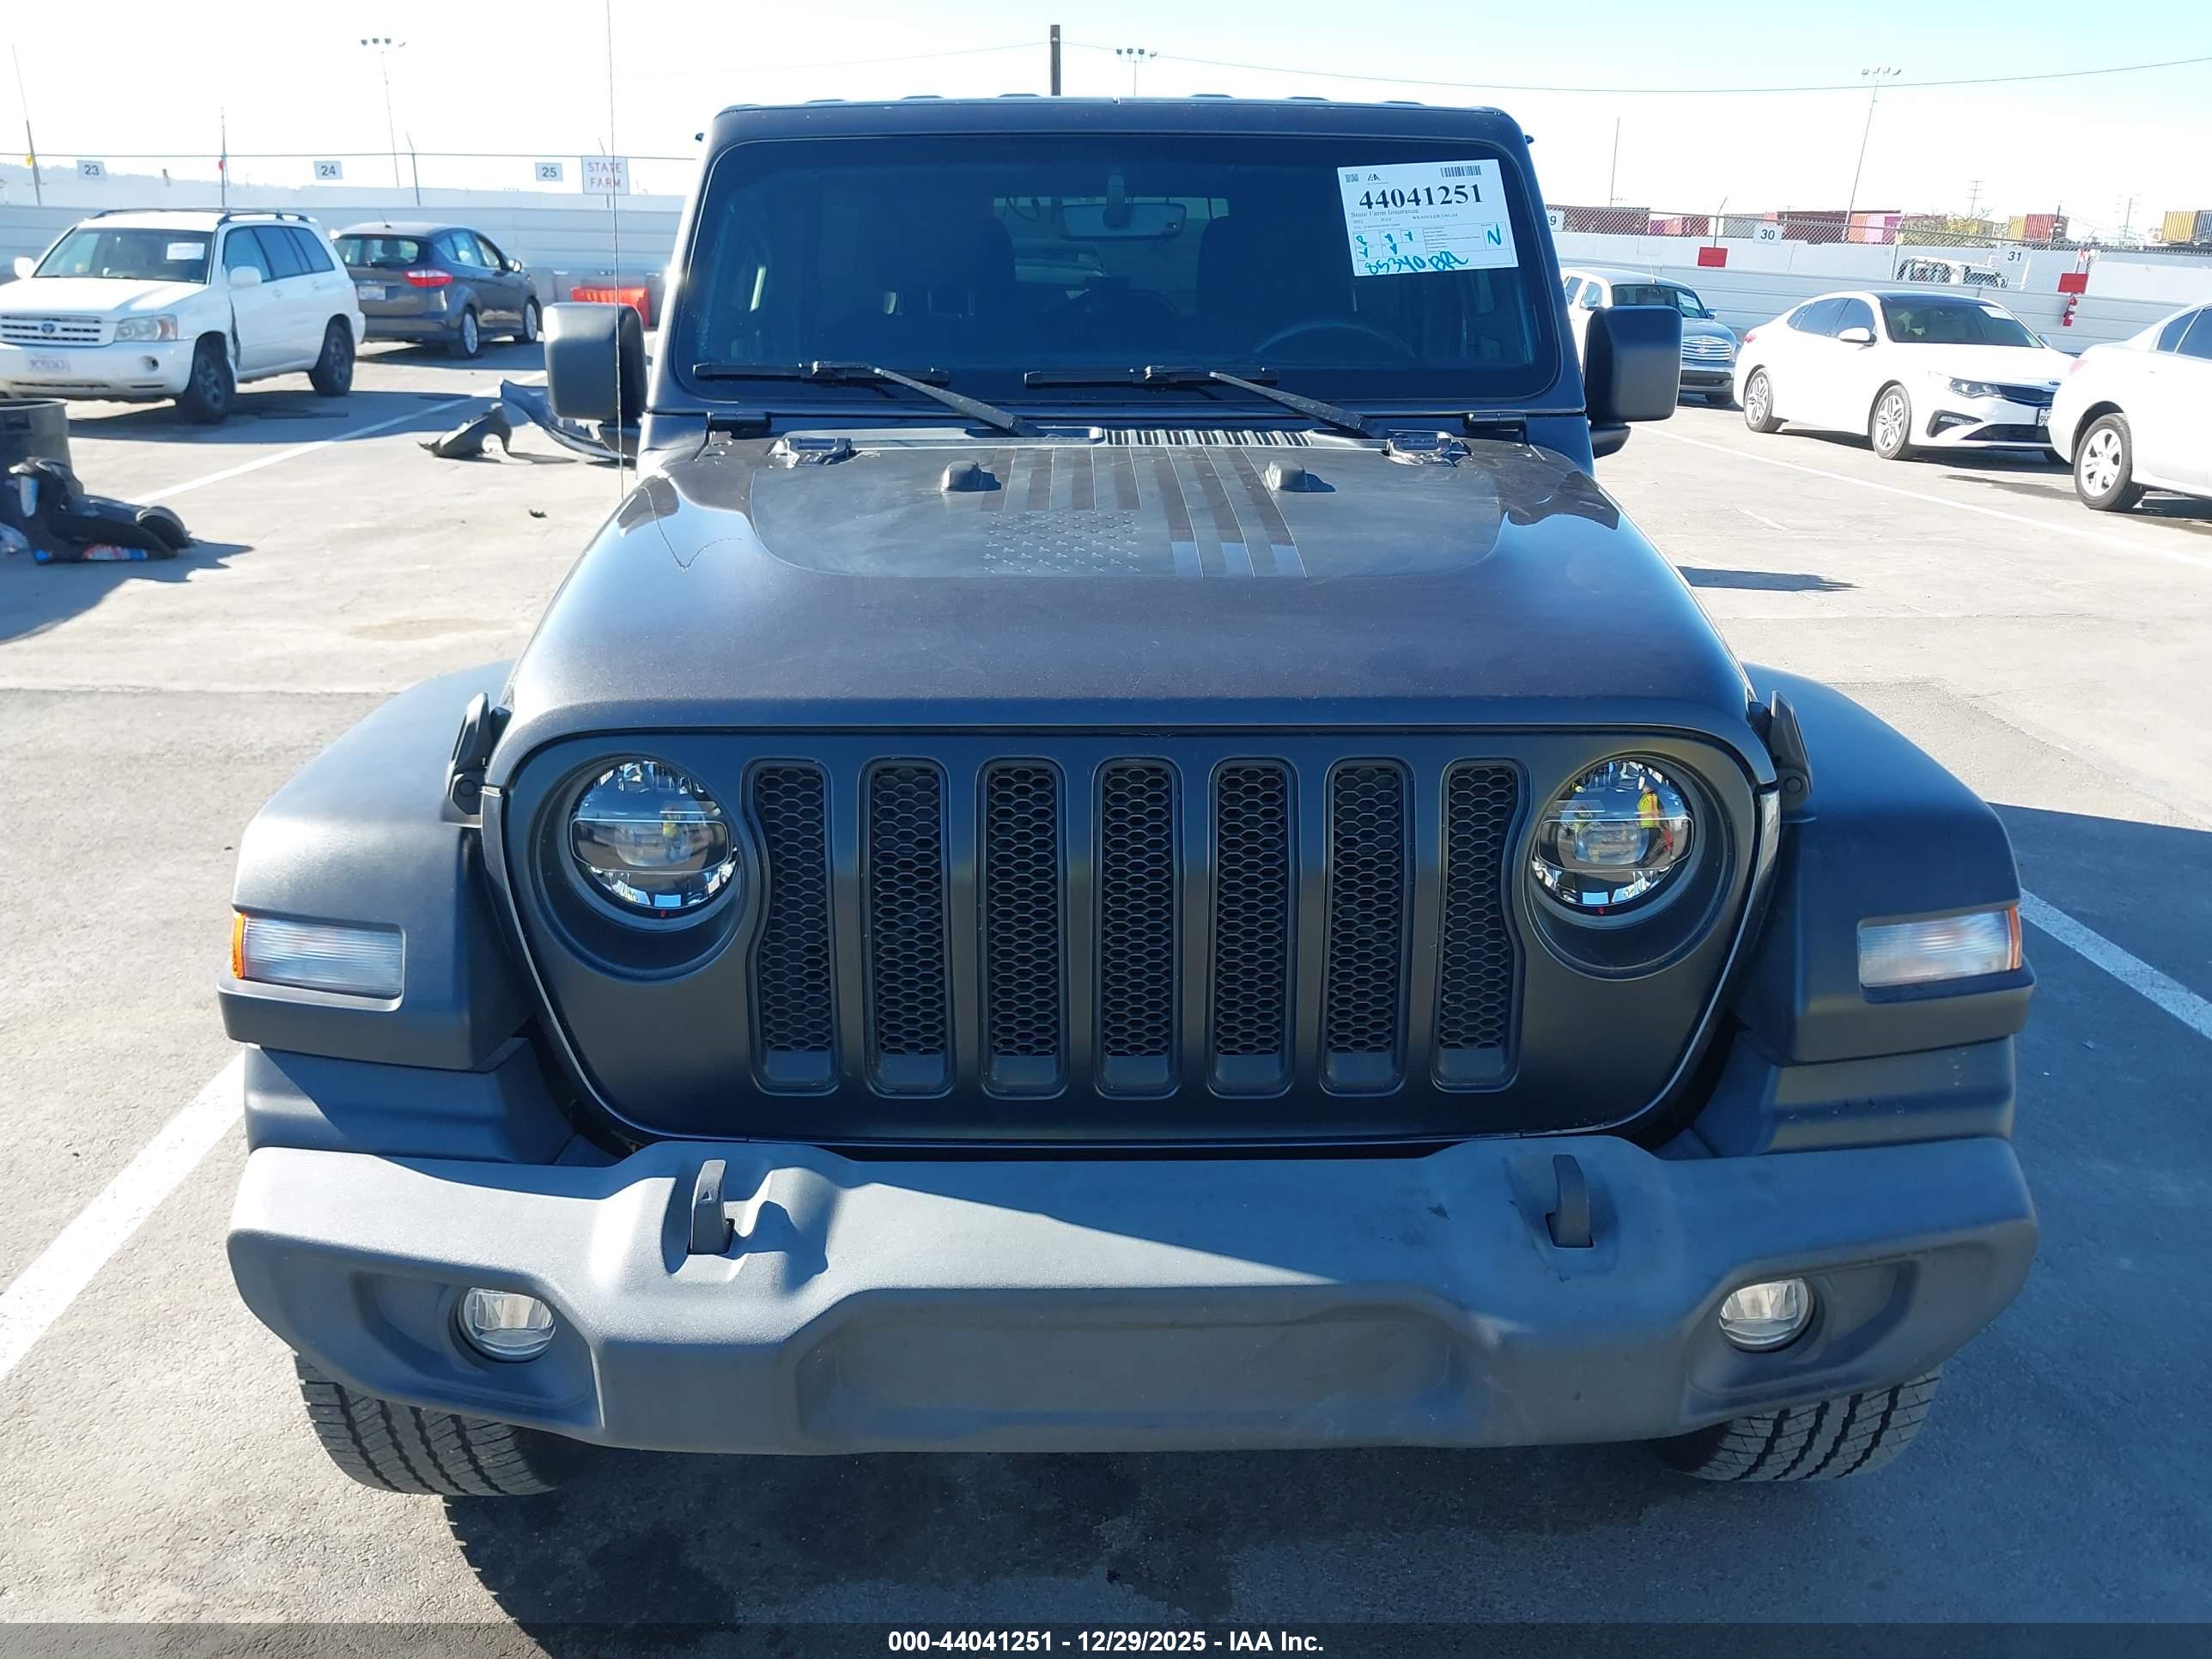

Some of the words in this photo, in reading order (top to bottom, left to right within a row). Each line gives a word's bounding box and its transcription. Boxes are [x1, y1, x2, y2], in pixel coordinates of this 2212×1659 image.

[83, 164, 100, 176] 23
[320, 165, 336, 176] 24
[542, 167, 557, 178] 25
[587, 161, 623, 173] STATE
[590, 178, 622, 189] FARM
[1359, 184, 1484, 210] 44041251
[1487, 223, 1503, 246] N
[1760, 228, 1776, 240] 30
[2007, 251, 2022, 261] 31
